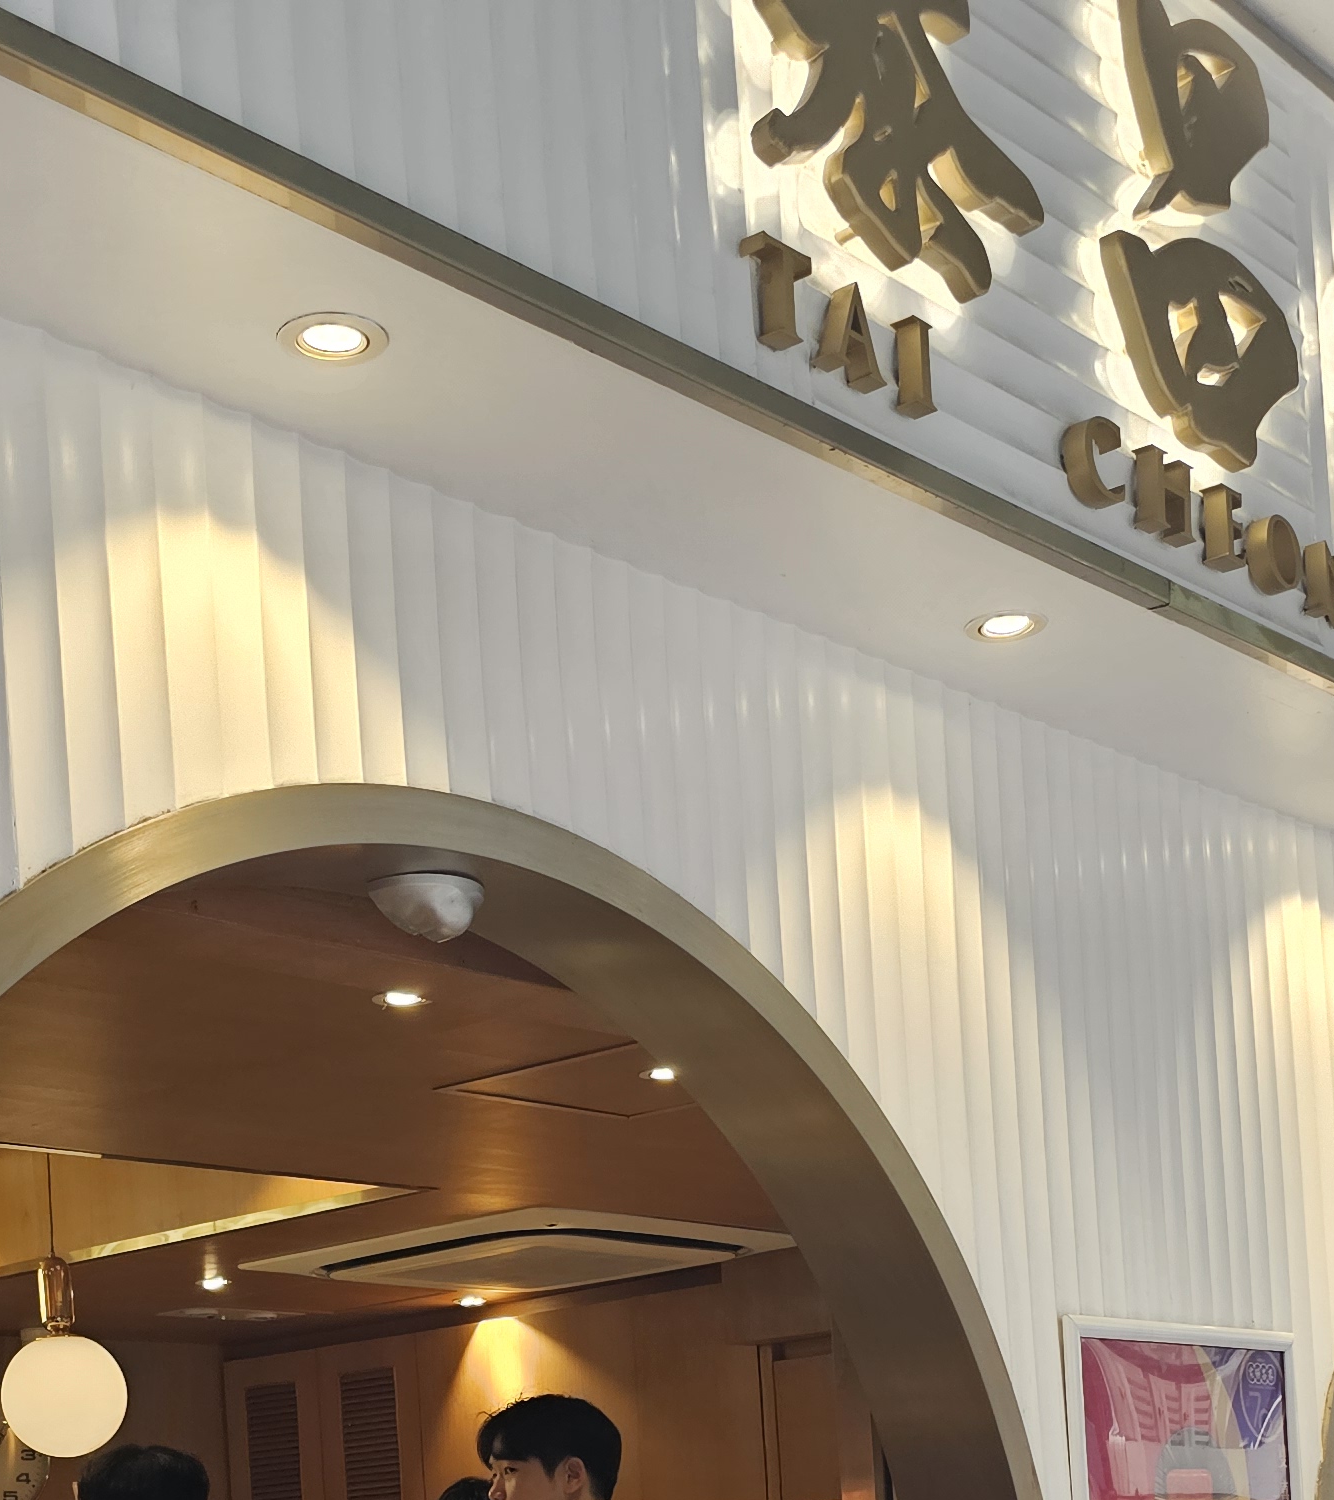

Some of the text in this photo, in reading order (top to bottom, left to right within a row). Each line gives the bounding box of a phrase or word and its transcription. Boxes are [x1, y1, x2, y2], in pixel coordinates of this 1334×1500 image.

[738, 230, 937, 419] TAI
[21, 1449, 36, 1460] 3
[16, 1473, 31, 1484] 4
